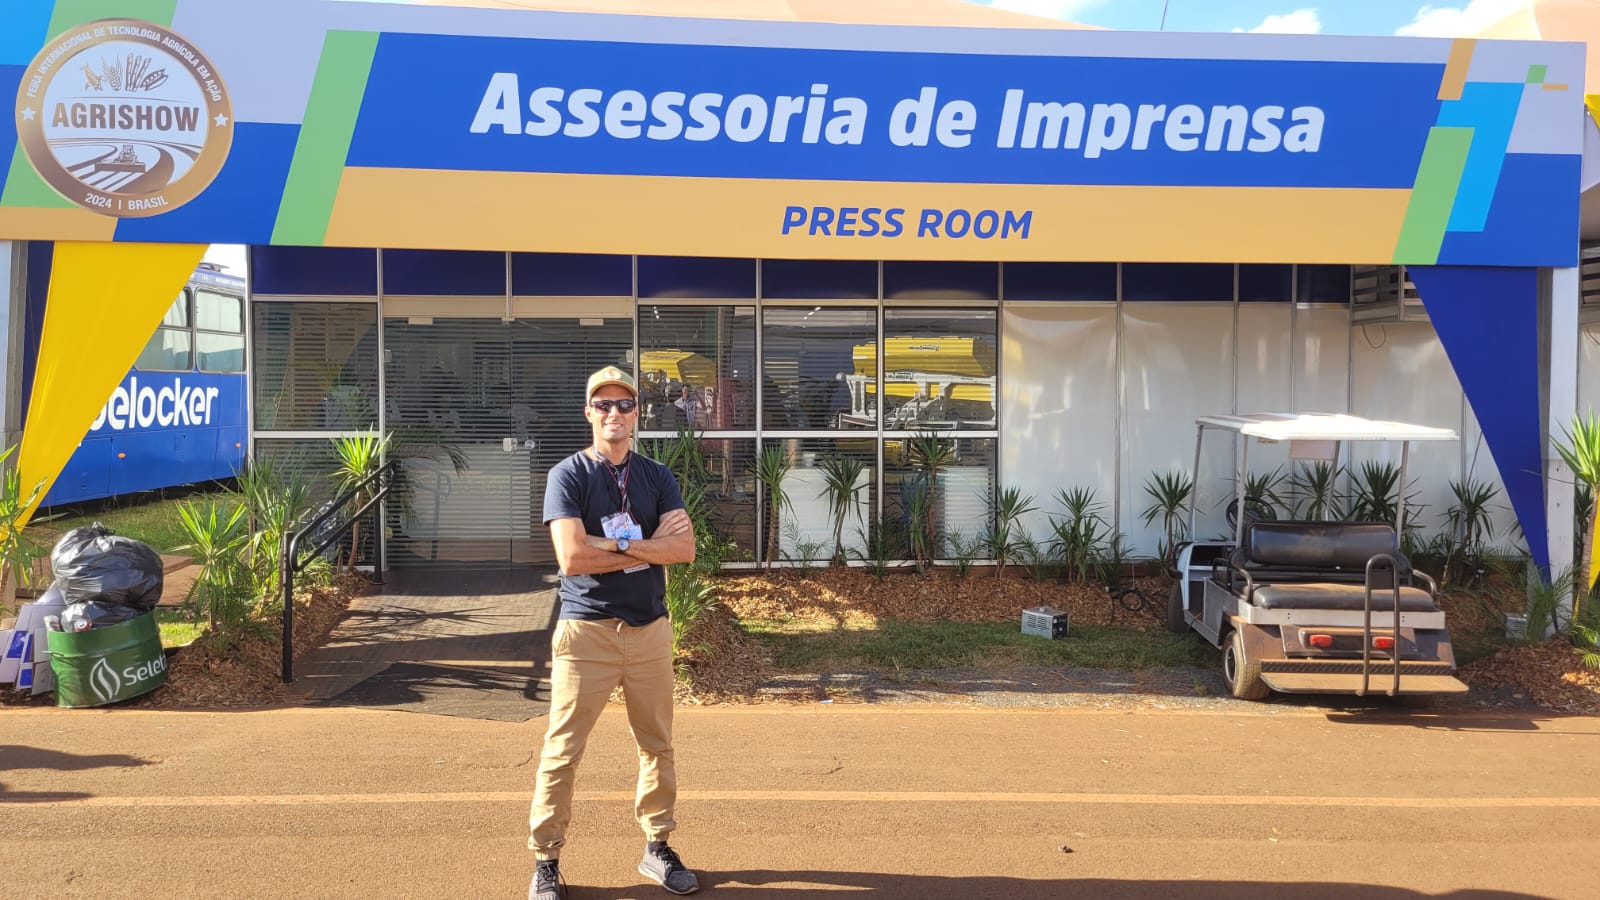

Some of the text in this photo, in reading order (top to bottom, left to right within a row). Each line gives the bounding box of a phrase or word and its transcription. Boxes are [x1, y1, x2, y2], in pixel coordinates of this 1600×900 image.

[94, 27, 106, 38] DE
[108, 26, 161, 42] TECNOLOGIA
[162, 36, 200, 68] AGRÍCOLA
[197, 64, 211, 80] EM
[205, 79, 223, 102] AÇÃO
[52, 102, 200, 132] AGRISHOW
[469, 72, 1326, 158] Assessoria de Imprensa
[84, 192, 113, 209] 2024
[127, 195, 169, 211] BRASIL
[781, 206, 1034, 240] PRESS ROOM
